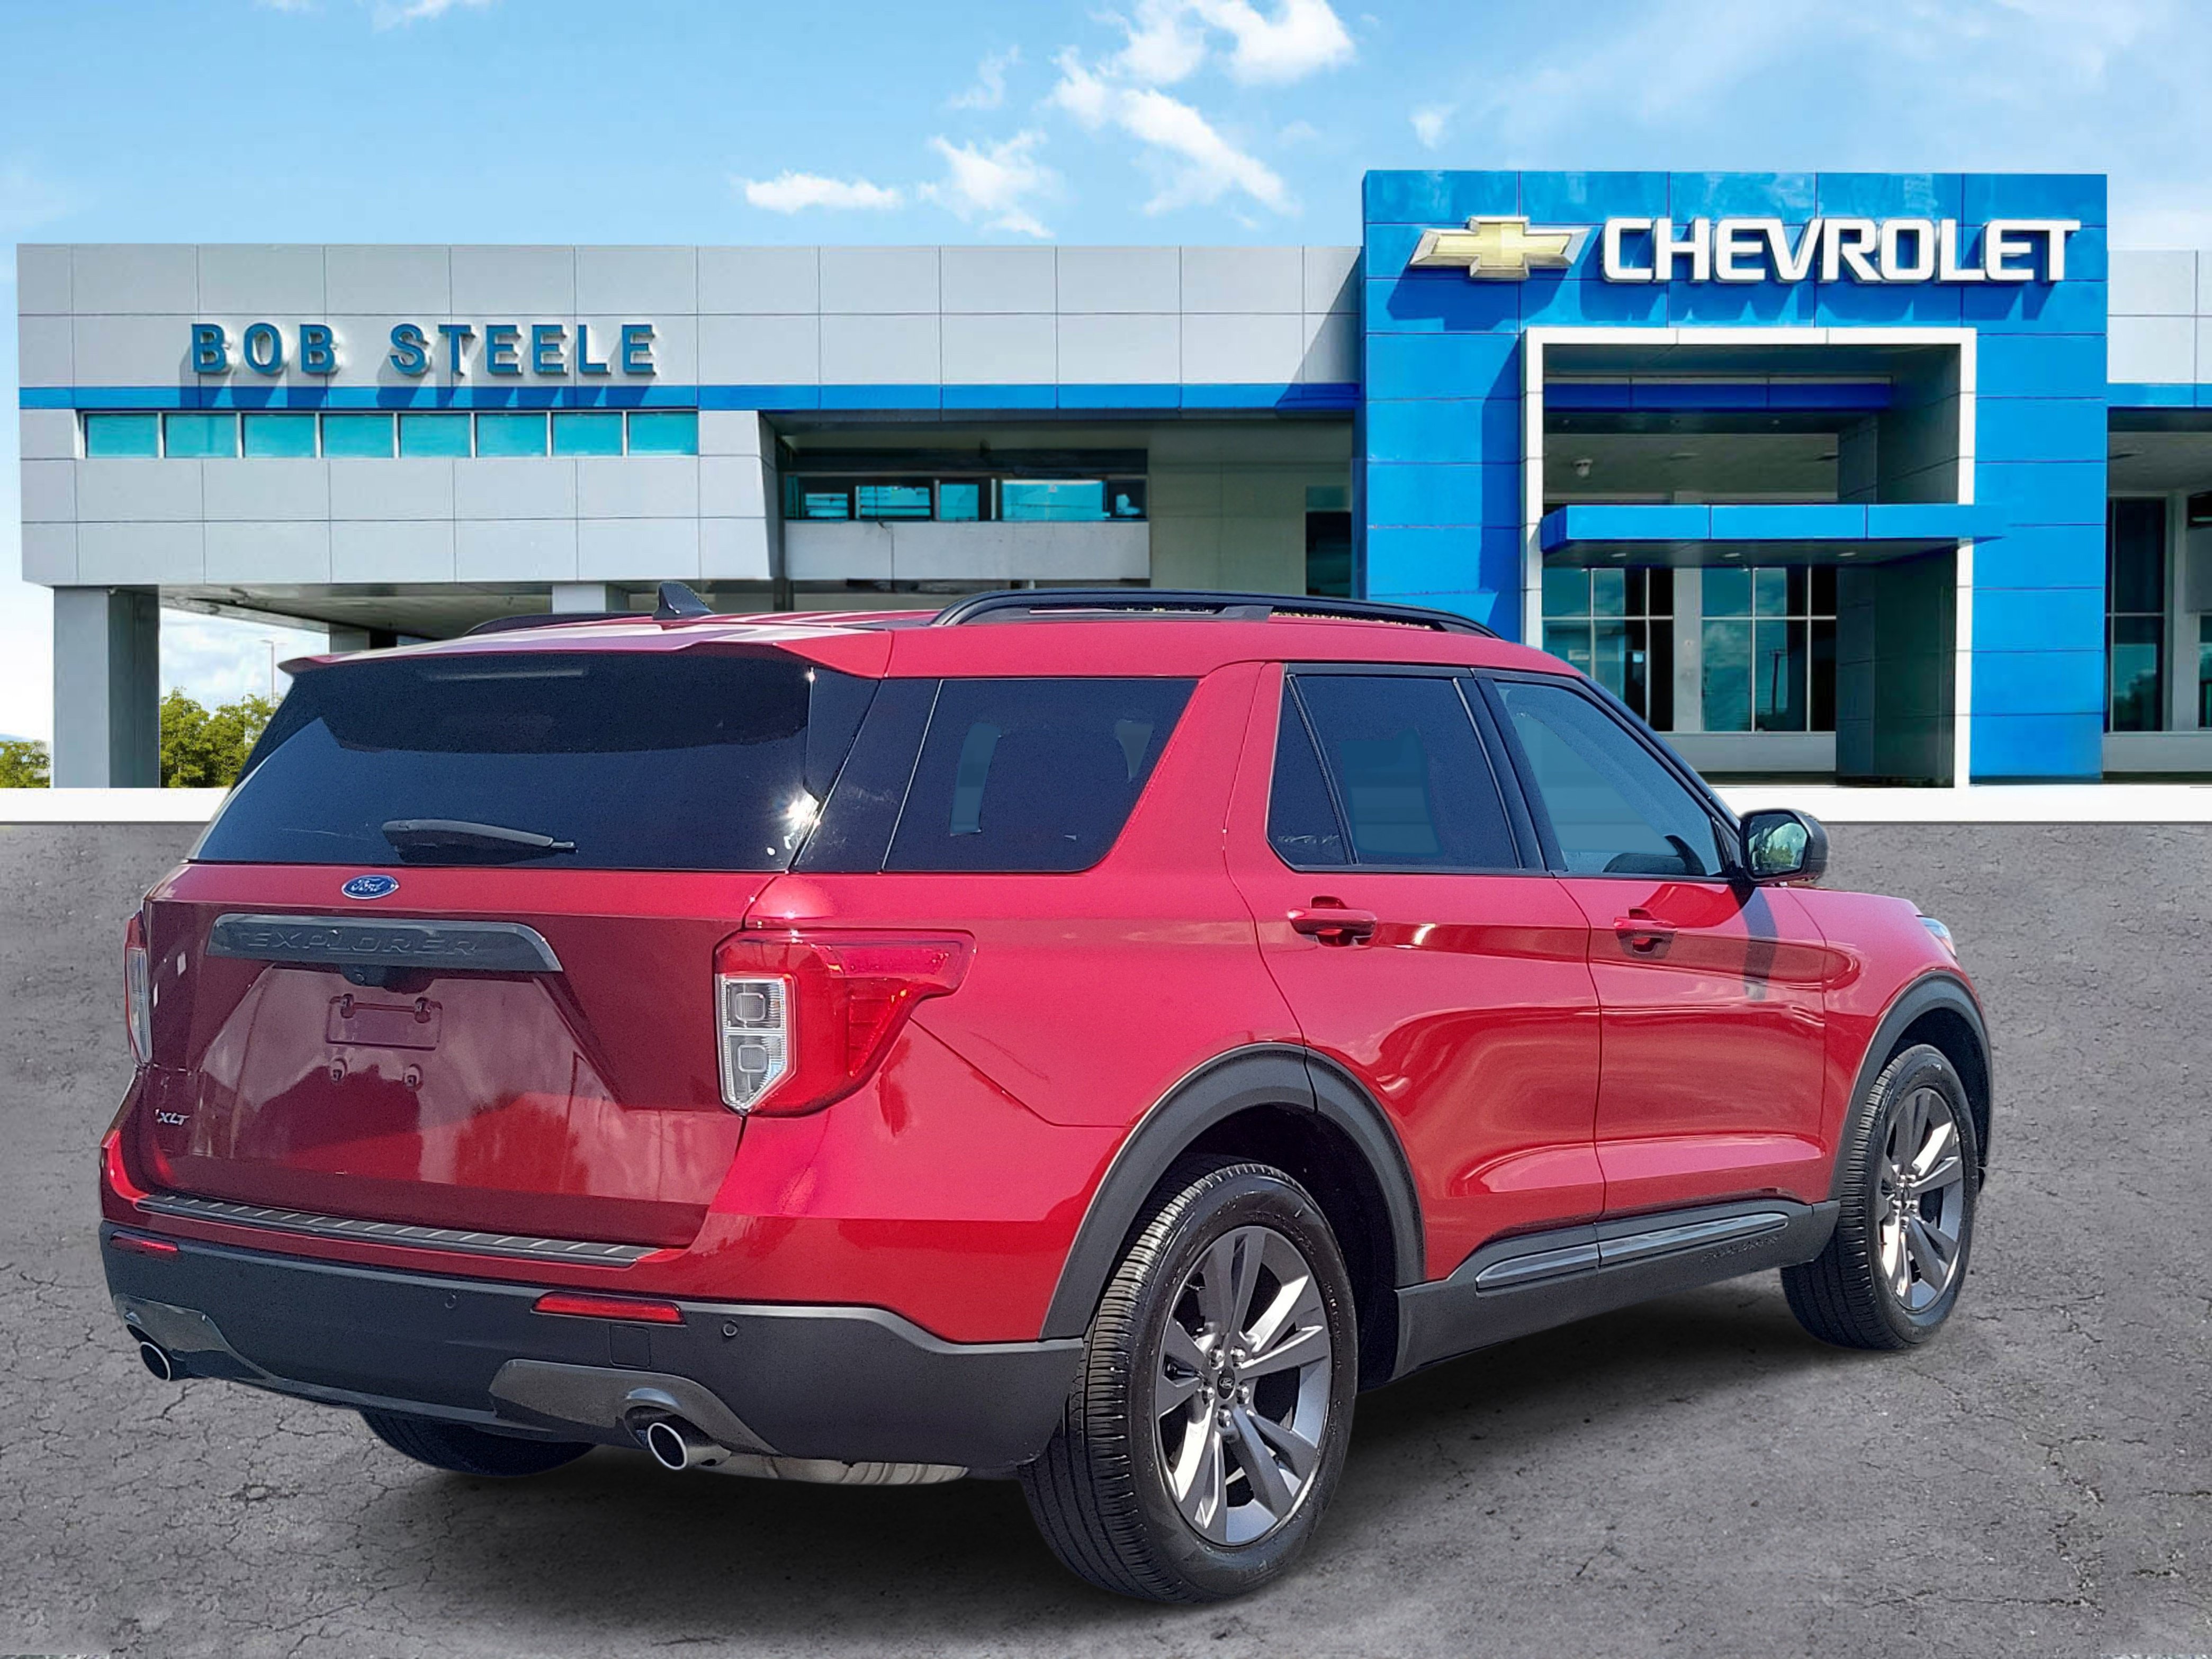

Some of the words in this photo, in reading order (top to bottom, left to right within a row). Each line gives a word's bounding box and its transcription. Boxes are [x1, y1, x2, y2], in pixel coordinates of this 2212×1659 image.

[1600, 218, 2081, 283] CHEVROLET
[191, 323, 339, 375] BOB
[390, 322, 656, 376] STEELE
[244, 930, 478, 955] EXPLORER
[157, 1112, 190, 1125] XLT
